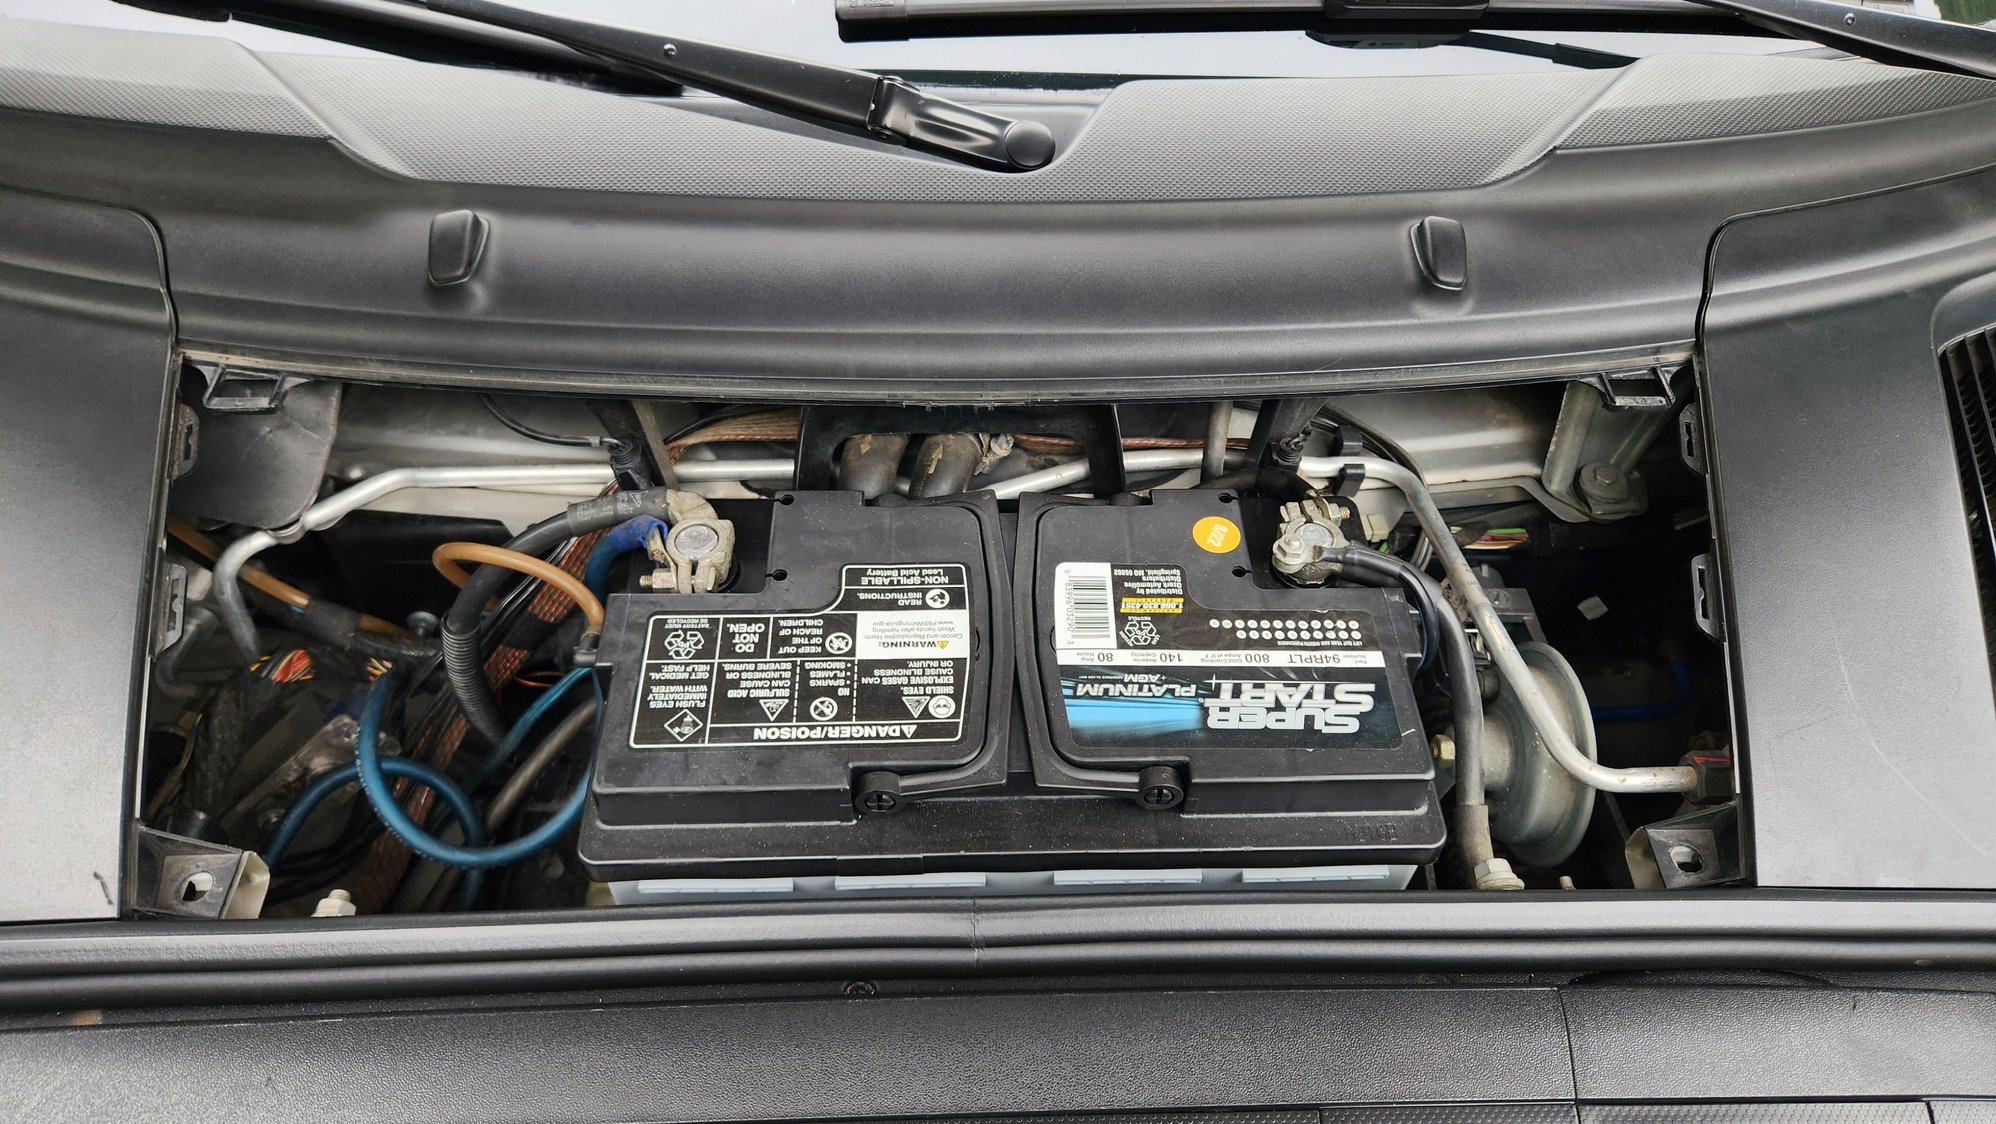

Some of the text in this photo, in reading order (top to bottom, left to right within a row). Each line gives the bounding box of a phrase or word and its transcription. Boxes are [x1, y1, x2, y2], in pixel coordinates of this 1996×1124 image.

[1207, 523, 1228, 547] 8/22
[866, 569, 898, 577] Battery
[922, 568, 943, 576] Lead
[861, 576, 948, 585] NON-SPILLABLE
[1066, 608, 1074, 631] 03290
[727, 623, 765, 632] OPEN.
[732, 633, 759, 643] NOT
[735, 643, 755, 653] DO
[1098, 652, 1114, 662] 80
[1160, 653, 1183, 663] 140
[1245, 654, 1269, 663] 800
[1288, 654, 1340, 664] 94RPLT
[757, 662, 792, 670] SEVERE
[649, 672, 689, 680] MEDICAL
[810, 670, 845, 678] FLAMES
[874, 668, 922, 676] BLINDNESS
[882, 677, 908, 685] GASES
[910, 675, 954, 684] EXPLOSIVE
[1124, 674, 1160, 682] AGM
[740, 680, 770, 688] CAUSE
[727, 689, 790, 698] SULFURIC ACID
[838, 688, 850, 696] NO
[901, 686, 954, 695] SHIELD EYES.
[1076, 684, 1196, 696] PLATINUM
[1204, 683, 1376, 712] START
[675, 700, 705, 708] FLUSH
[1206, 706, 1360, 734] SUPER
[754, 725, 900, 739] DANGER/POISON
